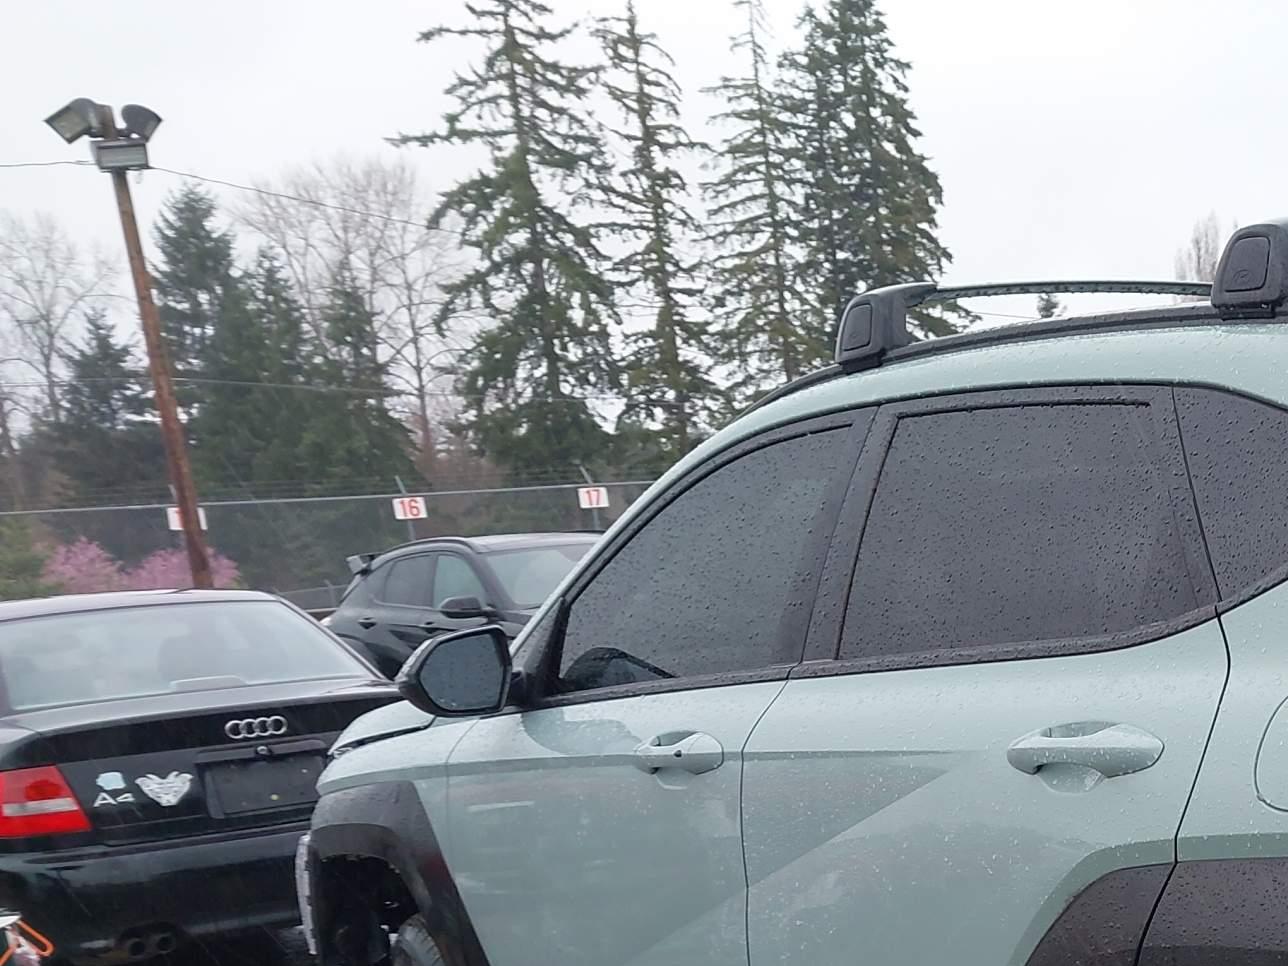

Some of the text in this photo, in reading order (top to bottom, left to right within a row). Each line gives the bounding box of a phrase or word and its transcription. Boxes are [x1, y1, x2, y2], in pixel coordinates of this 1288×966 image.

[585, 488, 601, 506] 17
[400, 498, 421, 517] 16
[93, 791, 136, 808] A4
